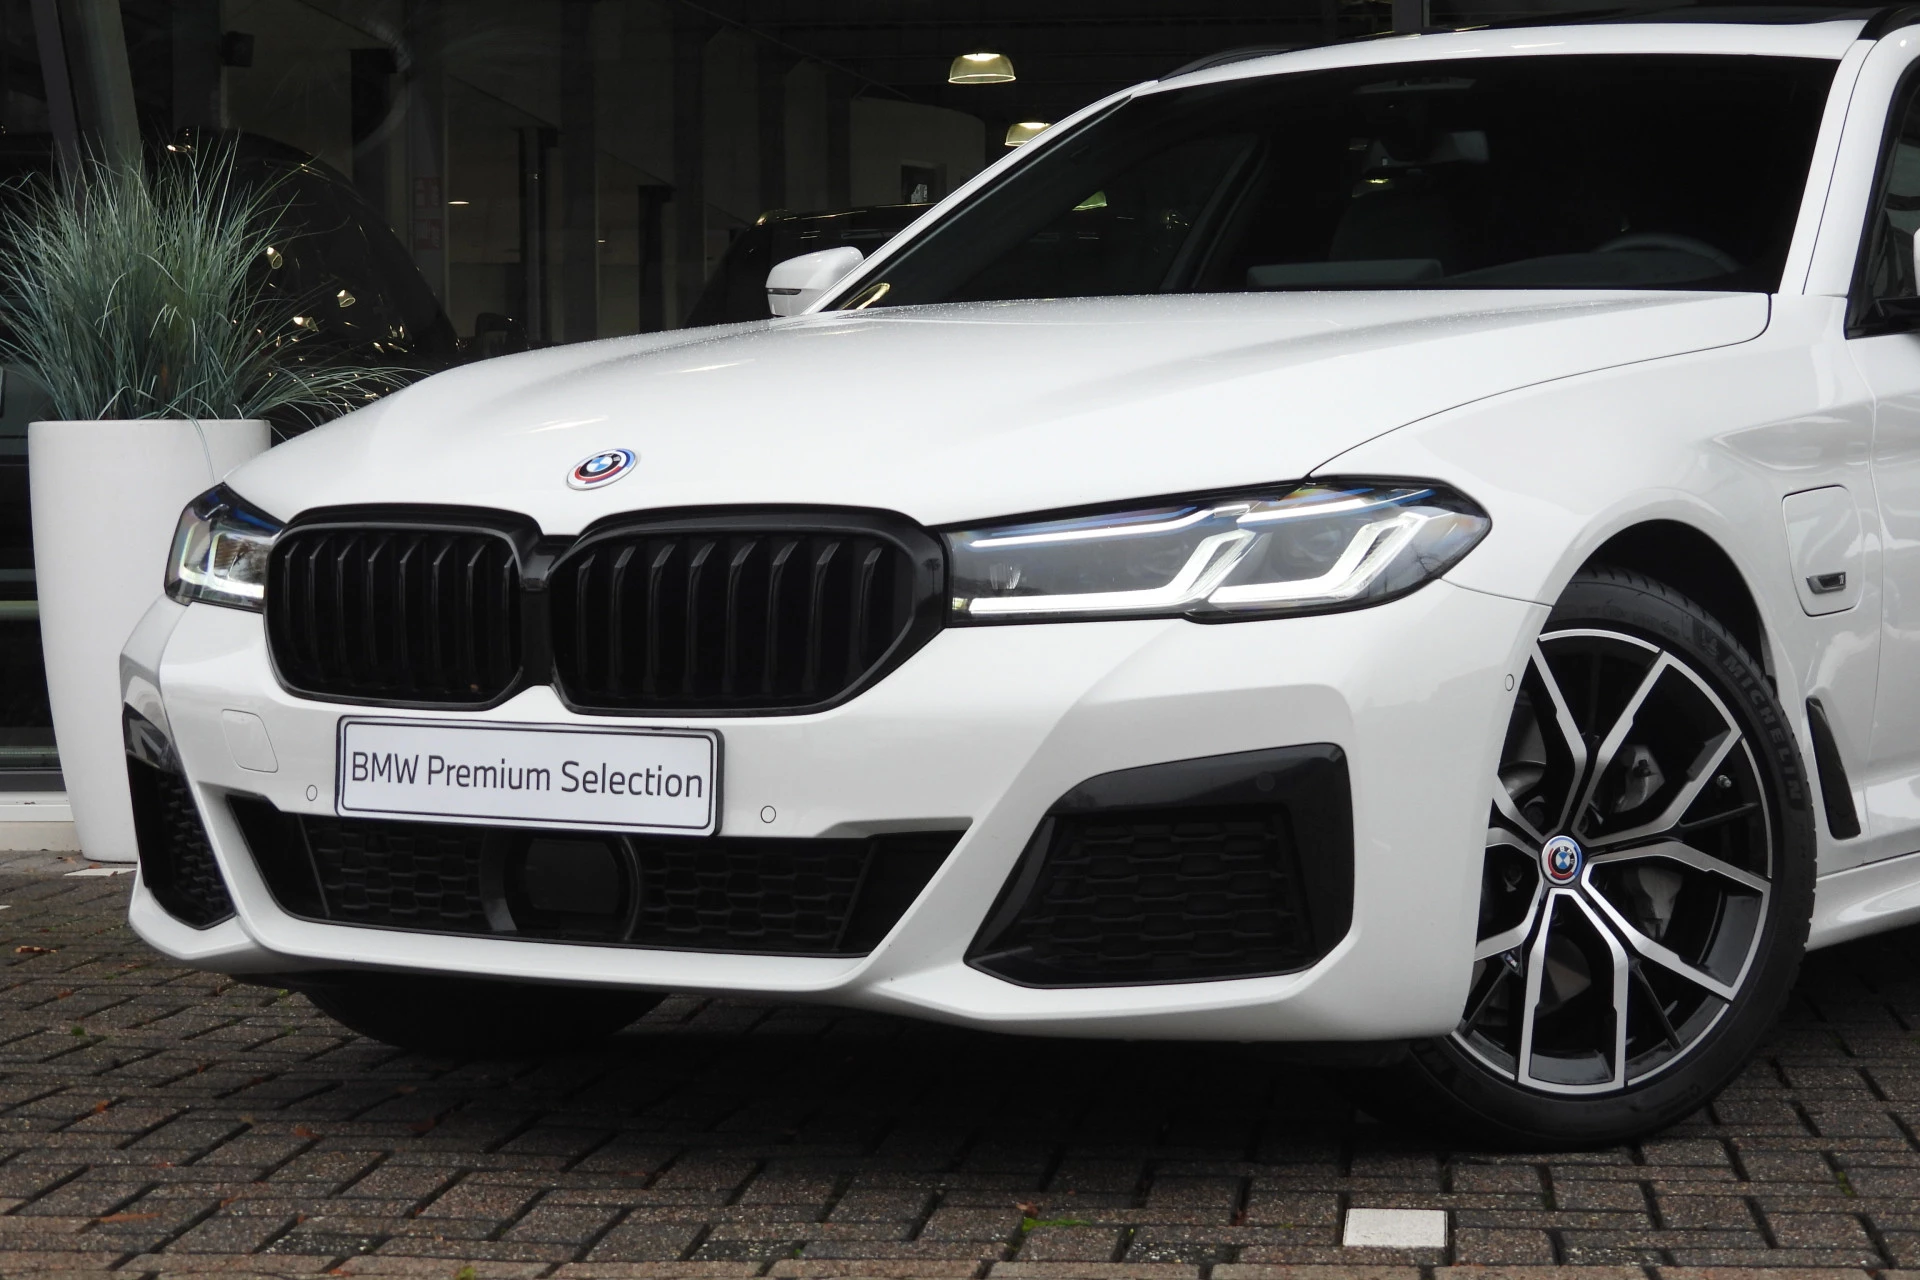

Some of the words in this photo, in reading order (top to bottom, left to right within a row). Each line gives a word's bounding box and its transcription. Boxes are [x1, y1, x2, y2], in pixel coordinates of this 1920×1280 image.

[352, 751, 419, 785] BMW
[428, 755, 551, 791] Premium
[561, 760, 703, 798] Selection
[1722, 656, 1802, 800] MICHELIN
